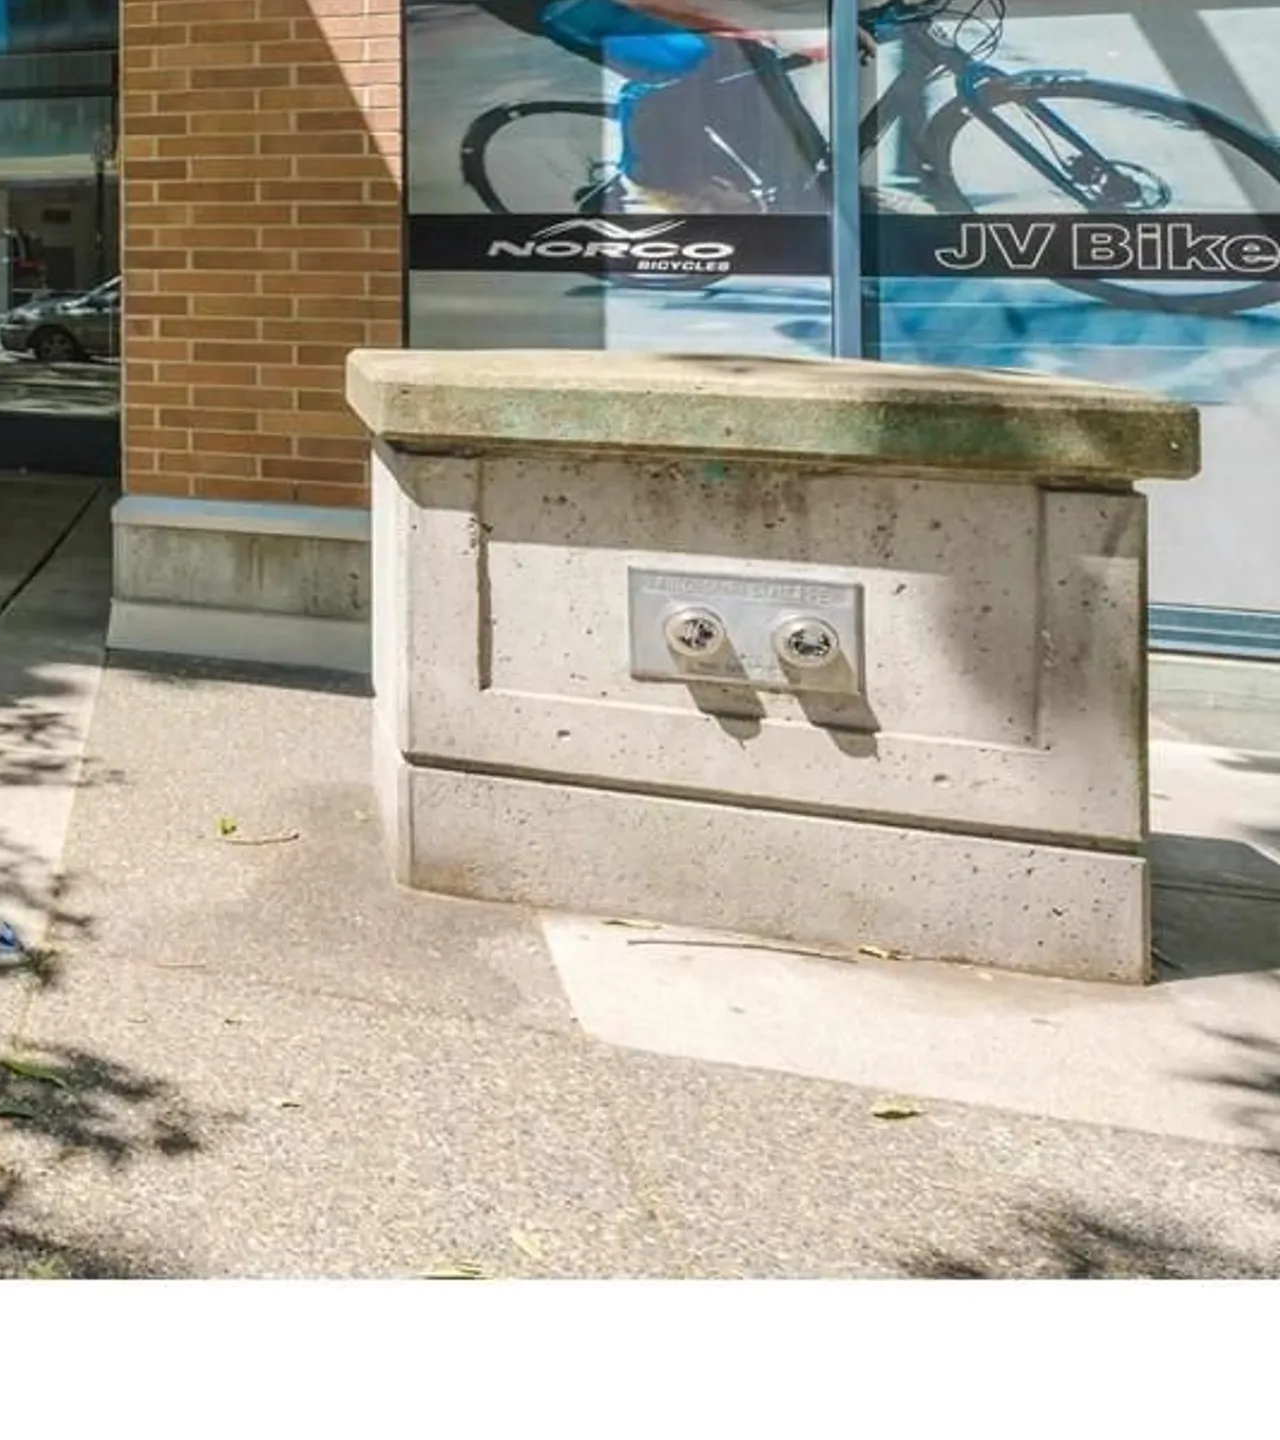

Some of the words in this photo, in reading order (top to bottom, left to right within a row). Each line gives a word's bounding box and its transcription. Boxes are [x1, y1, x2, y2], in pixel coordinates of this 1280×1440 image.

[488, 241, 735, 259] NORCO
[934, 223, 1056, 269] JV
[1072, 223, 1280, 272] Bike
[636, 259, 731, 272] BICYCLES
